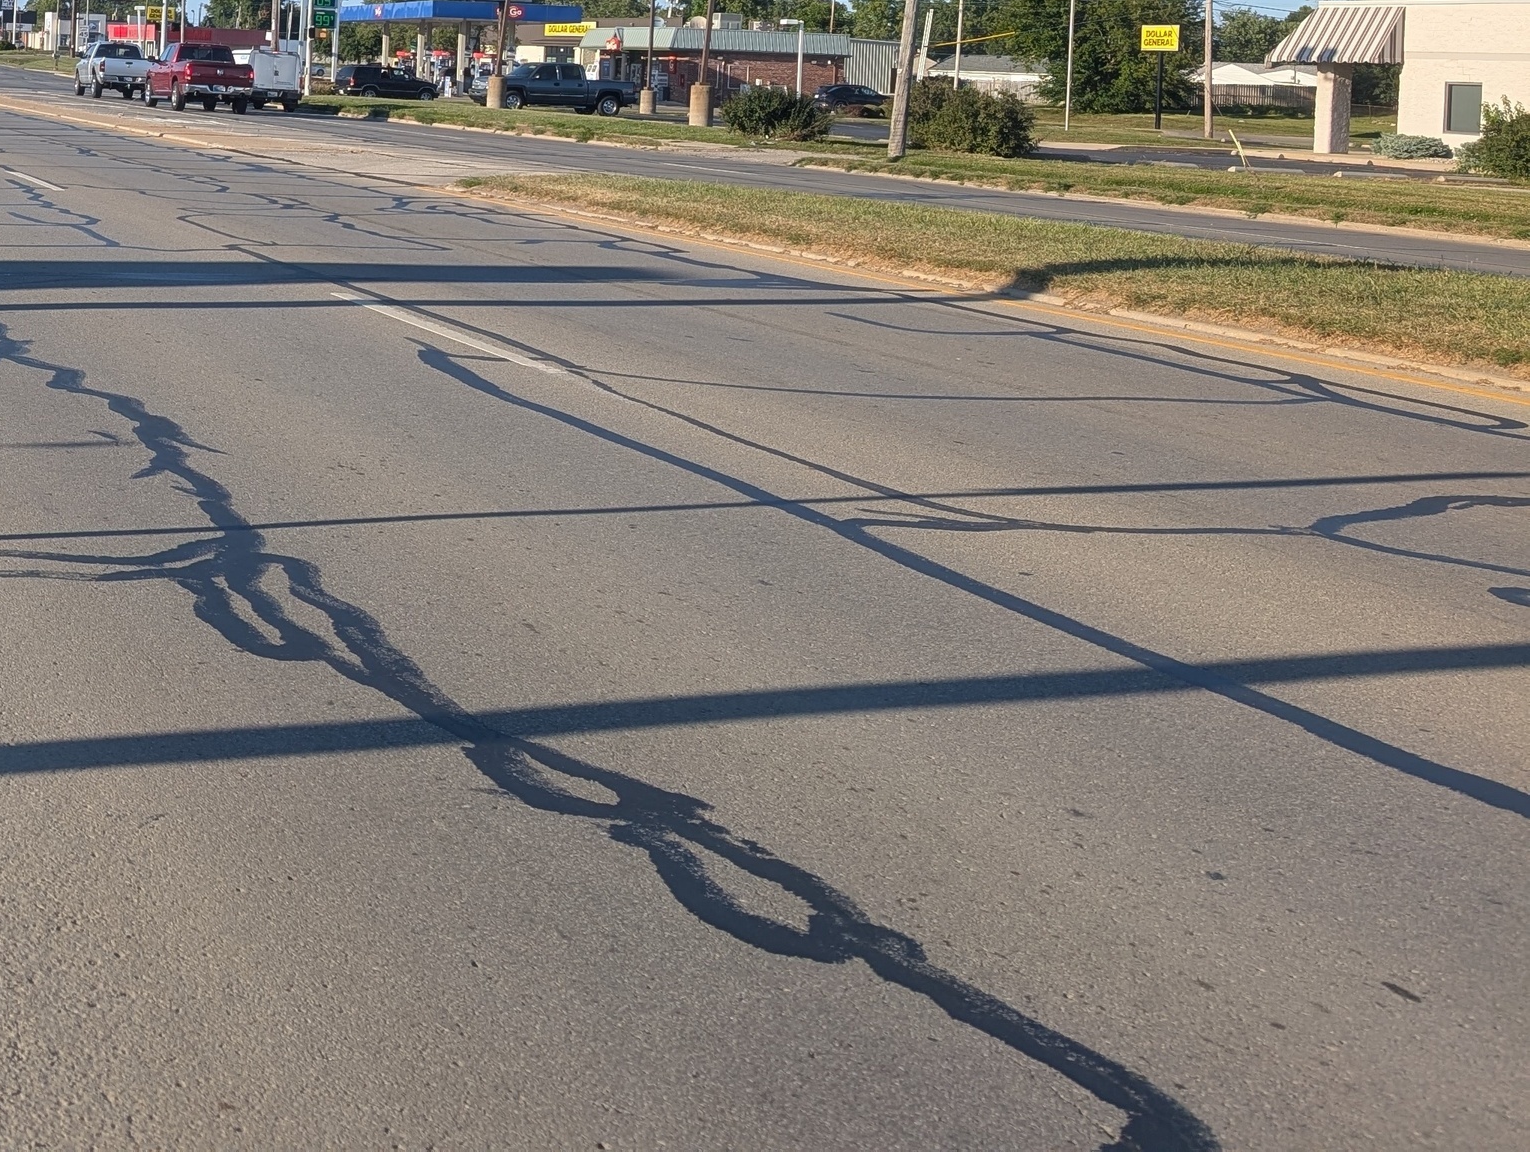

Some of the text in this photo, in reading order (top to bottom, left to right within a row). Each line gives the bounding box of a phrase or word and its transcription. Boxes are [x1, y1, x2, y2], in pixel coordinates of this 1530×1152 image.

[549, 25, 591, 33] DOLLAR GENERA
[1146, 30, 1173, 38] DOLLAR
[1143, 39, 1174, 47] GENERAL
